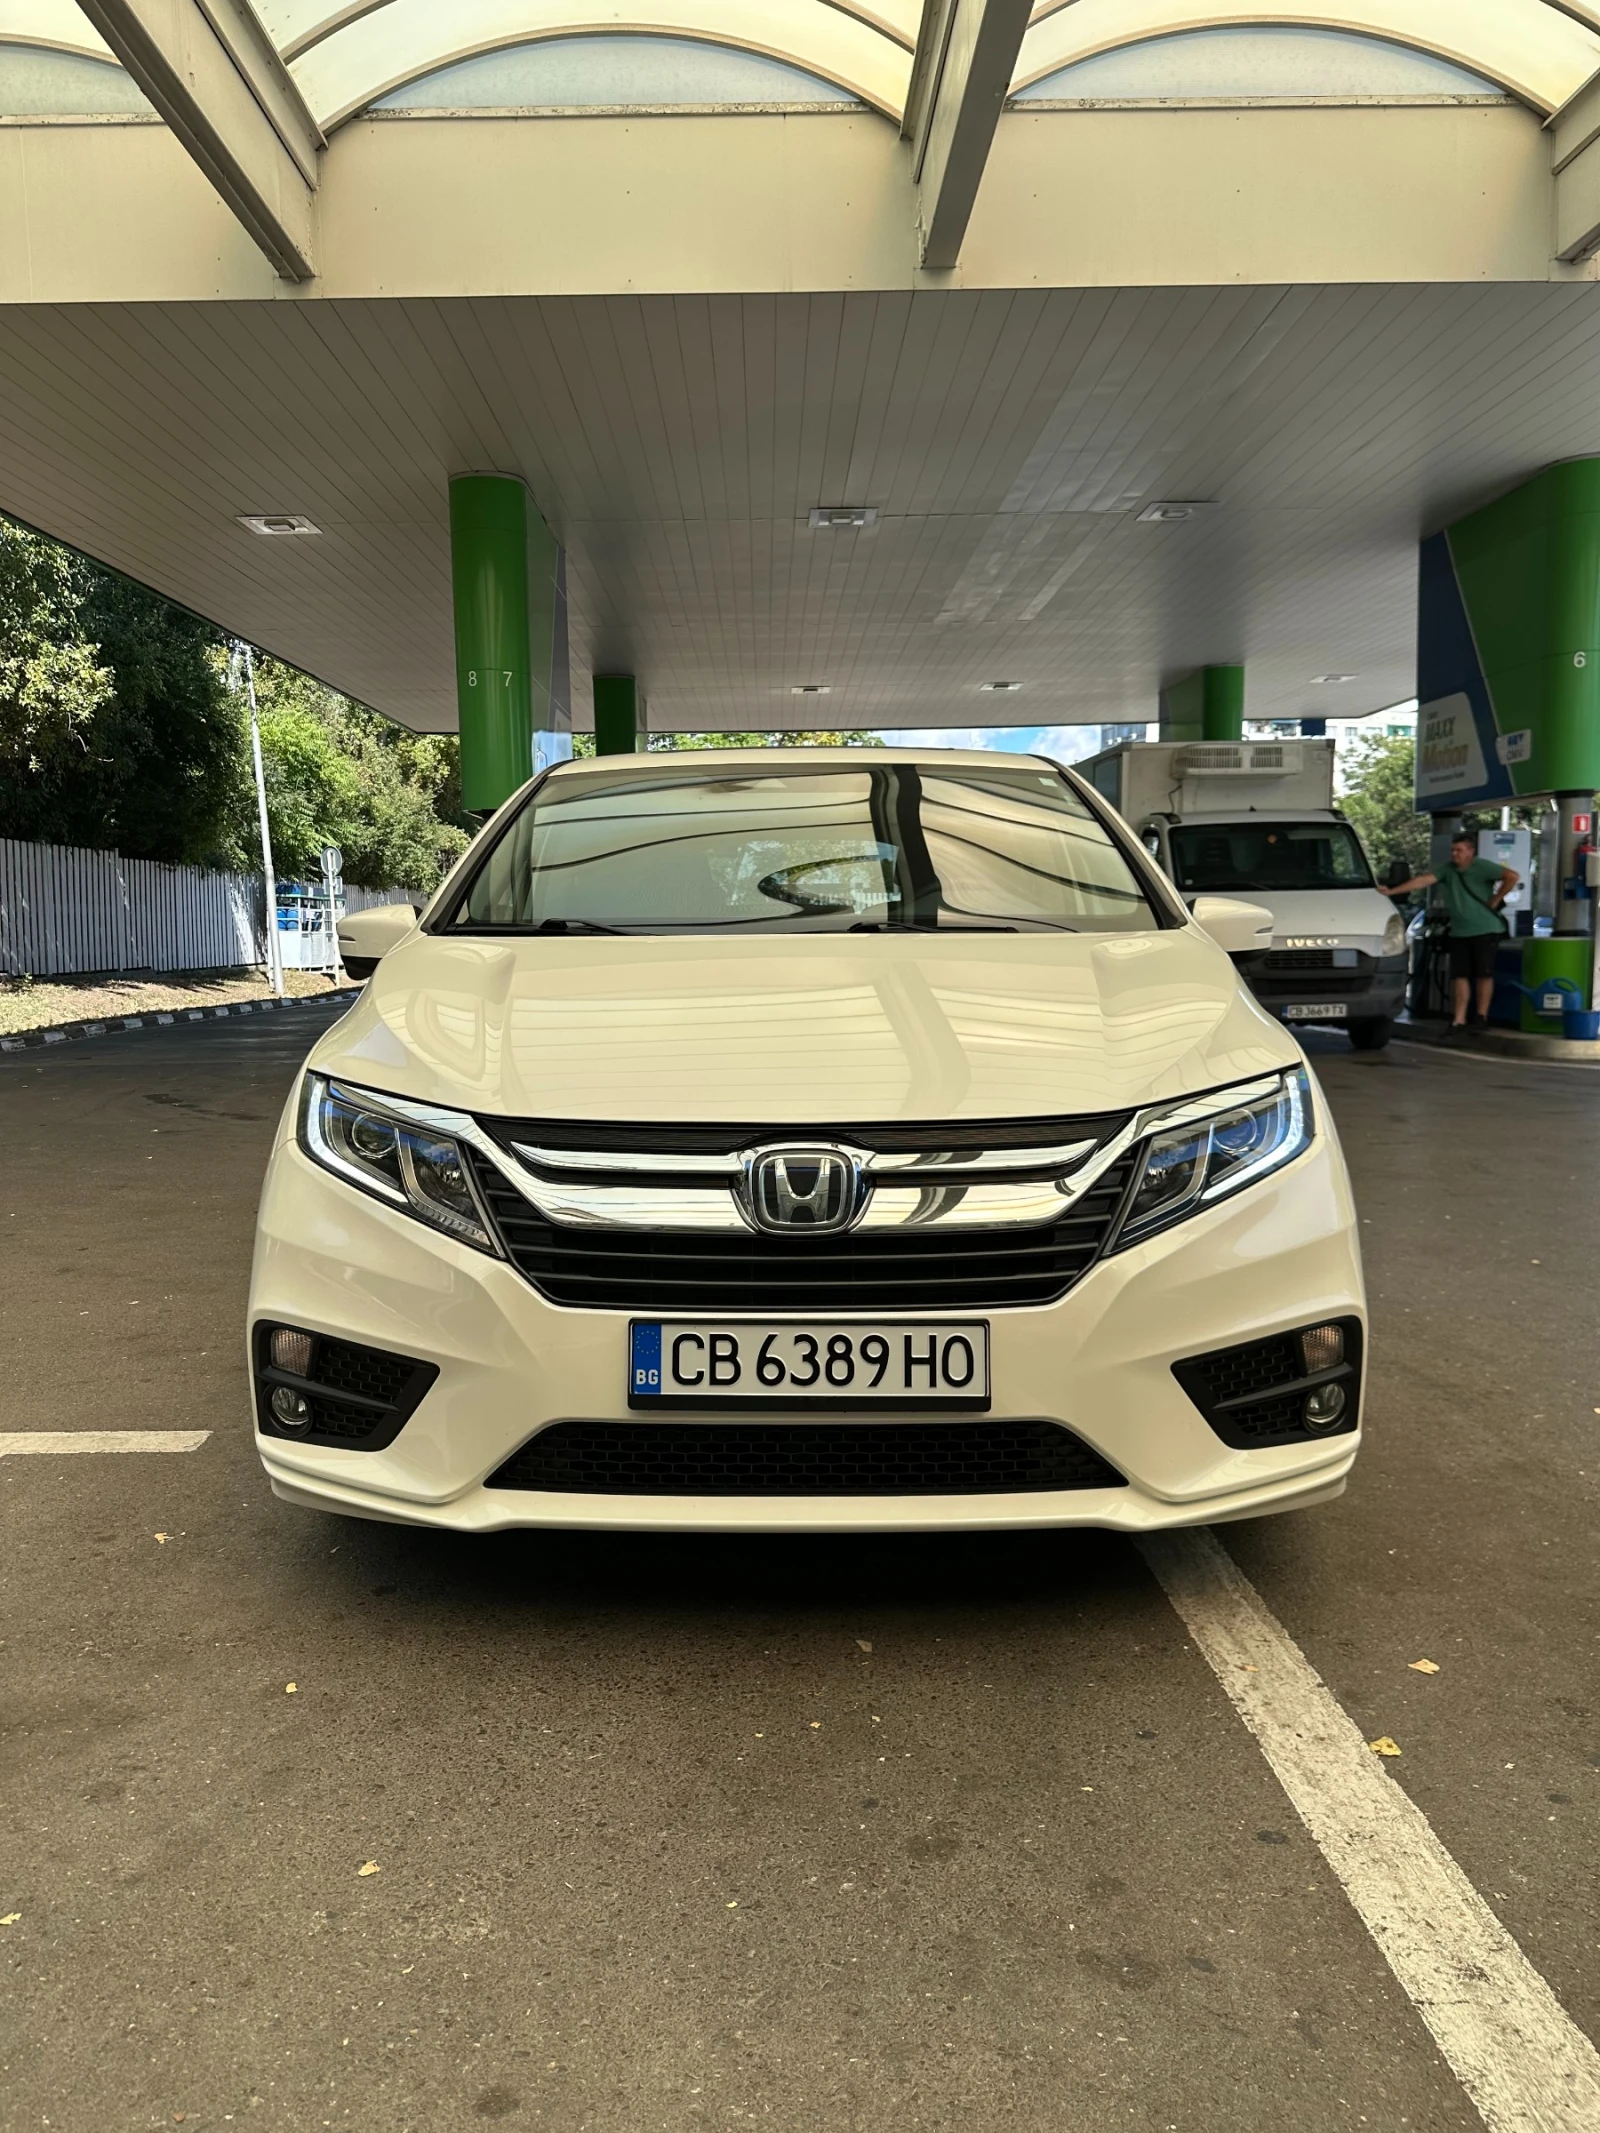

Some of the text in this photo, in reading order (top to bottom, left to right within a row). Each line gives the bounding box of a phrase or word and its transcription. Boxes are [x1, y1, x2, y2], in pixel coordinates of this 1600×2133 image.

[1574, 651, 1586, 668] 6
[468, 671, 477, 687] 8
[503, 671, 512, 687] 7
[1286, 938, 1339, 948] IVECO
[636, 1369, 659, 1385] BG
[672, 1332, 742, 1386] CB
[756, 1333, 890, 1387] 6389
